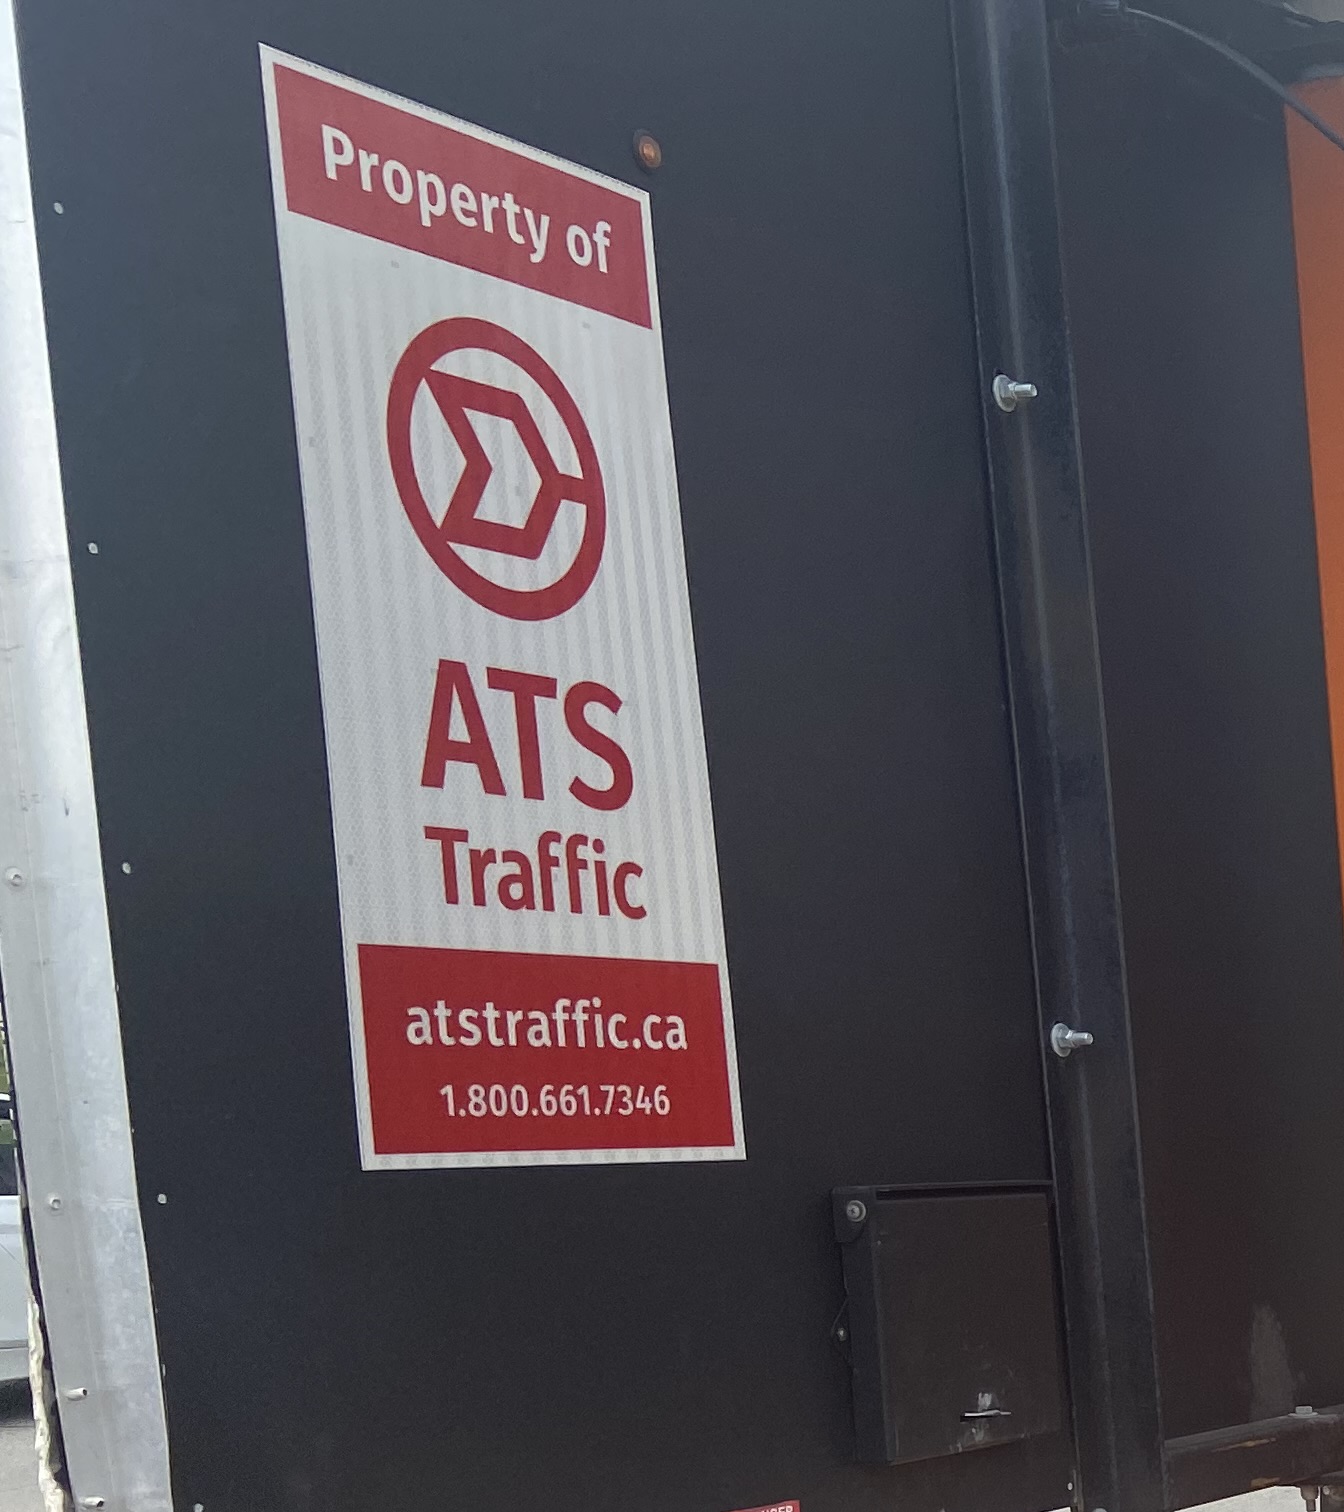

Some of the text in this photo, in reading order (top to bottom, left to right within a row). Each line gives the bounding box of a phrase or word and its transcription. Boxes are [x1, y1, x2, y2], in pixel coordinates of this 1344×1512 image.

[320, 124, 611, 273] Property of
[420, 658, 634, 811] ATS
[423, 826, 647, 920] Traffic
[406, 997, 688, 1050] atstraffic.ca
[440, 1084, 671, 1118] 1.800.661.7346
